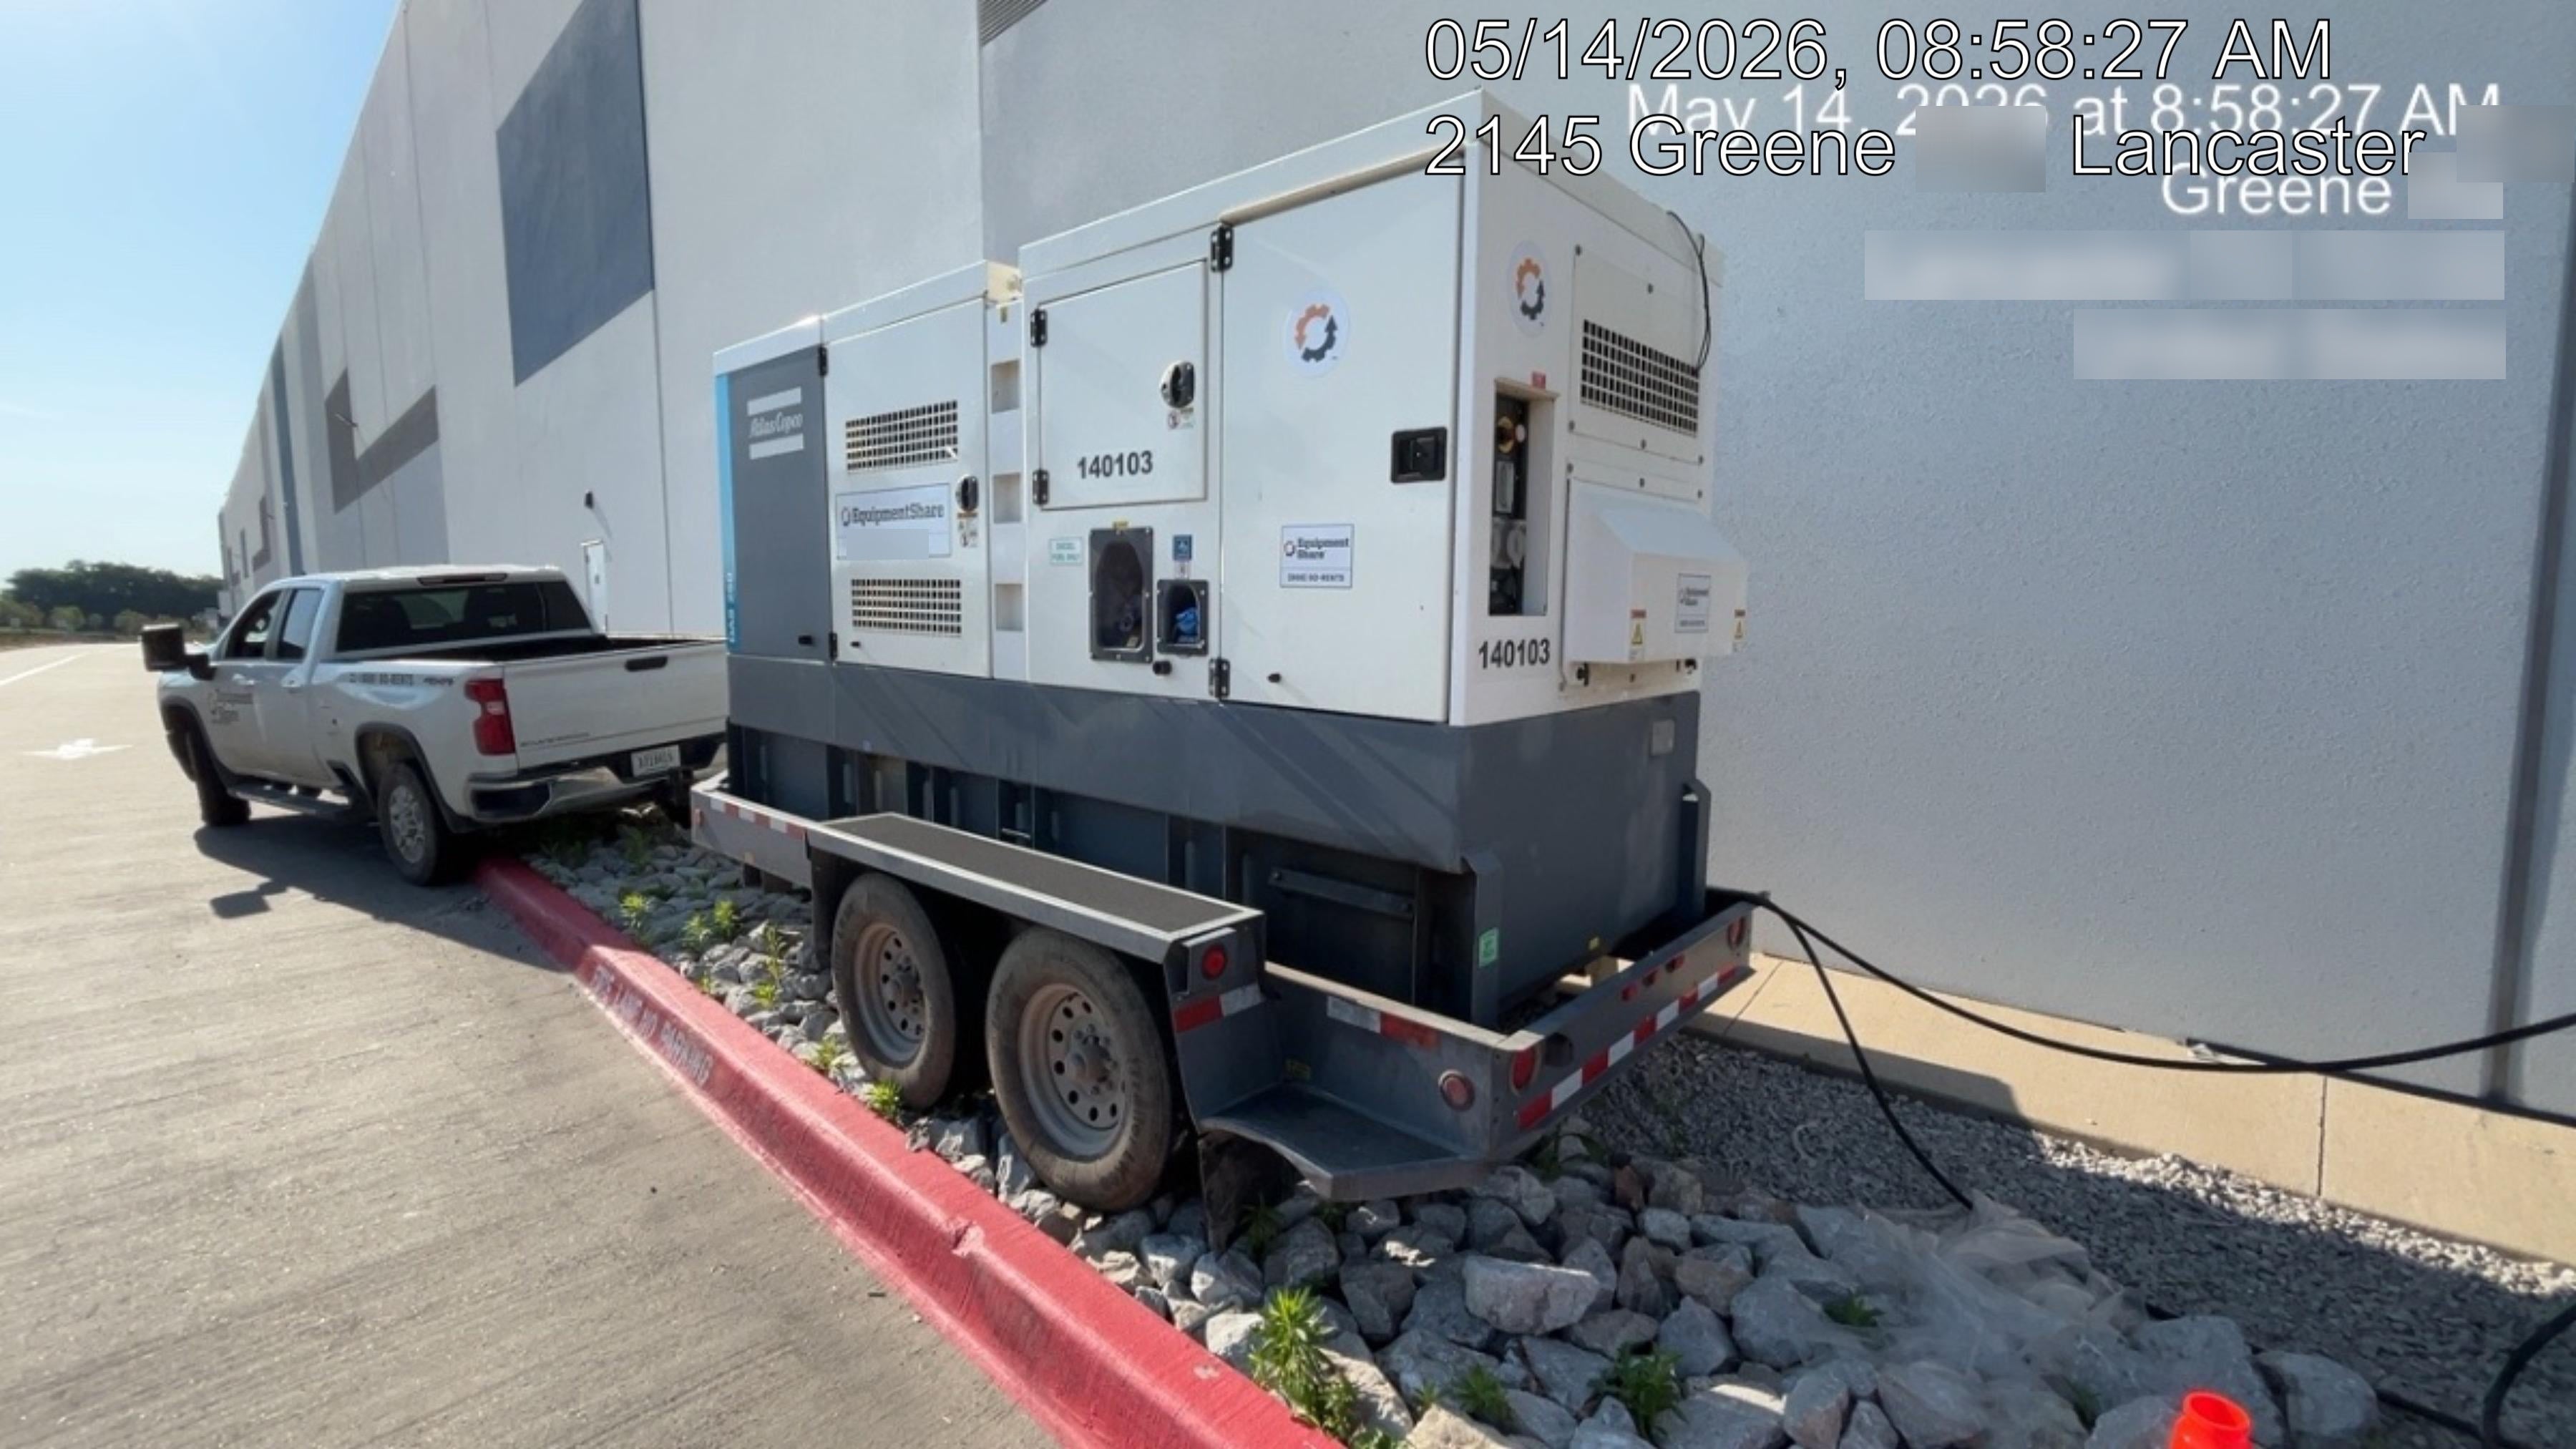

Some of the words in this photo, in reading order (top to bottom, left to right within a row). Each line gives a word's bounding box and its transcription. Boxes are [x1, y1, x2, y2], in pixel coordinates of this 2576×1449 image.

[1077, 450, 1153, 479] 140103
[852, 502, 945, 527] EquipmentShare
[1298, 537, 1349, 550] Equipment
[1478, 638, 1551, 669] 140103
